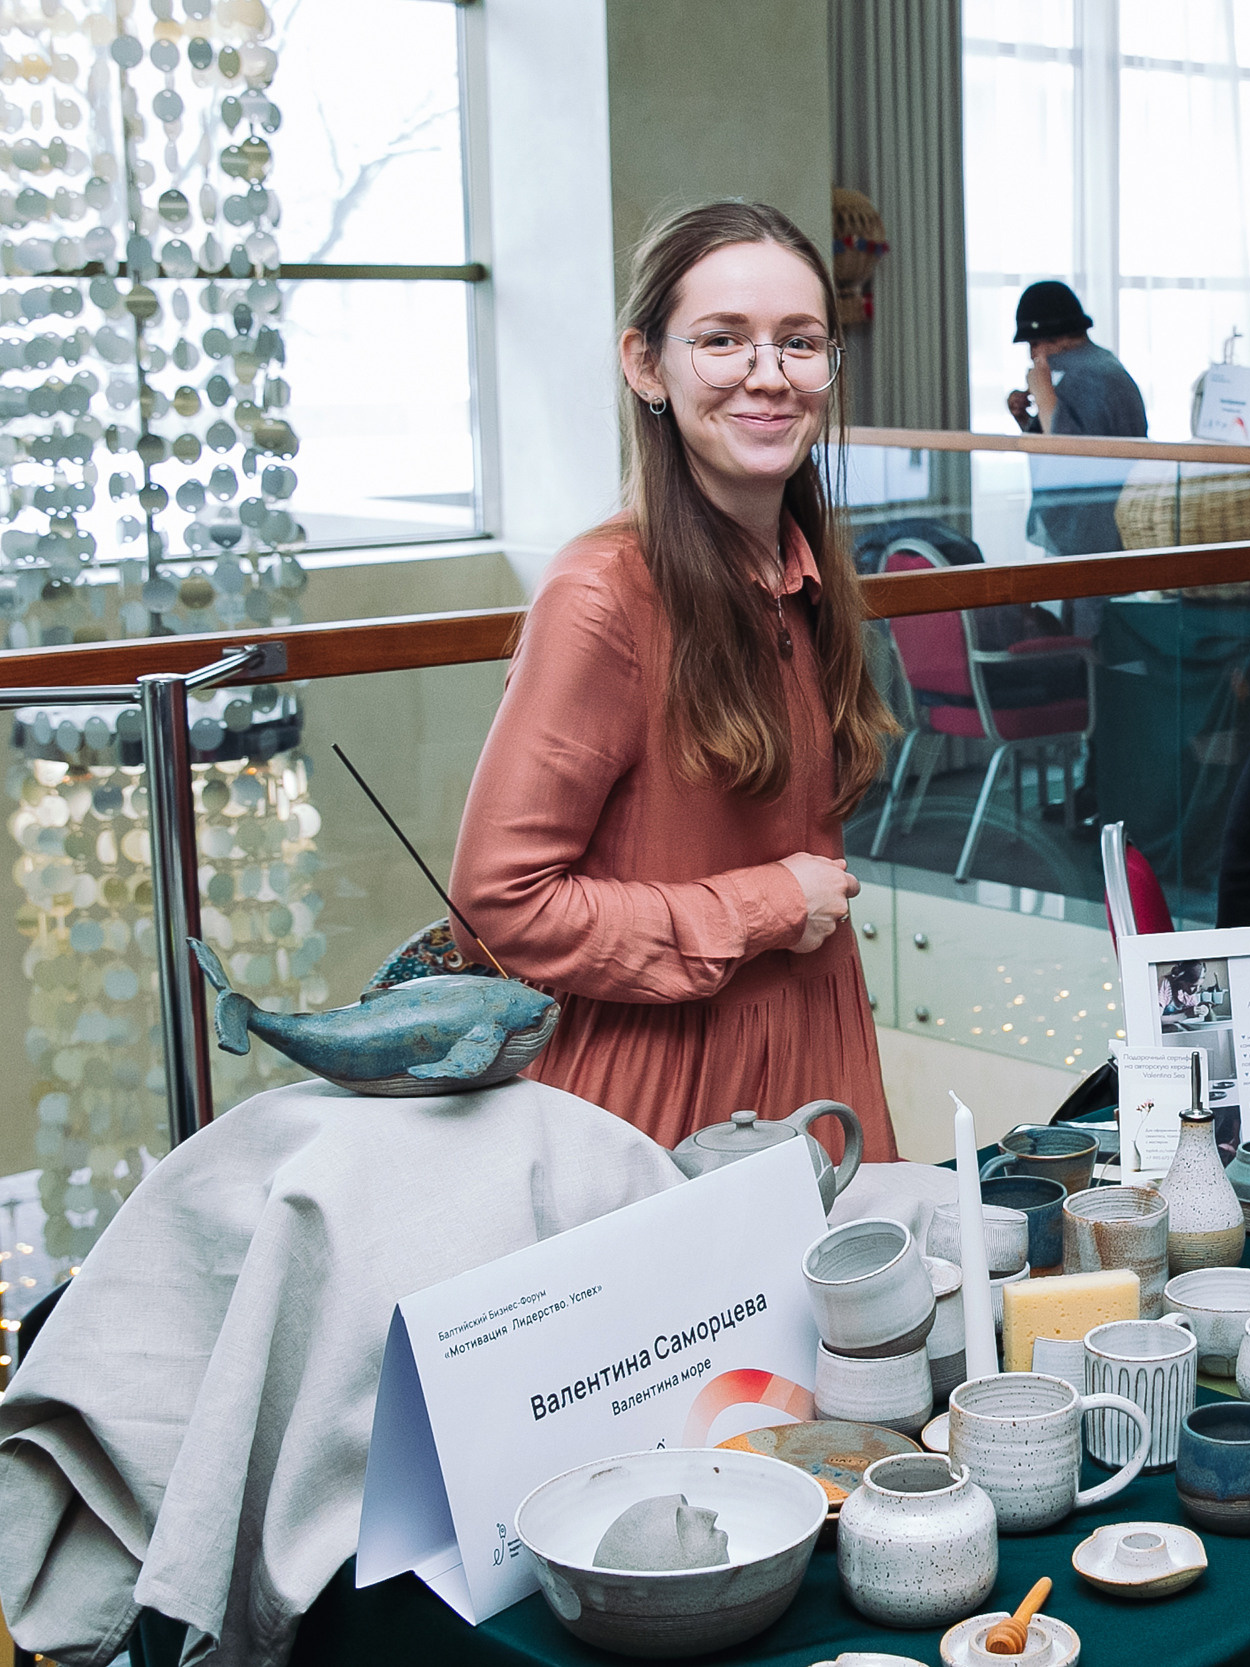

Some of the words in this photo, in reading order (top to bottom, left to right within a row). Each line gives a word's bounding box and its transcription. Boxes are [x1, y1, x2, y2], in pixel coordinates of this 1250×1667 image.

[1123, 1053, 1165, 1061] Подарочный
[1166, 1054, 1203, 1062] сертифт
[438, 1313, 488, 1342] Балтийский
[488, 1289, 547, 1321] Бизнес-Форум
[512, 1299, 569, 1331] Лидерство.
[569, 1284, 603, 1305] Успех»
[530, 1348, 652, 1421] Валентина
[653, 1292, 769, 1360] Саморцева
[611, 1371, 680, 1416] Валентина
[680, 1357, 713, 1385] море
